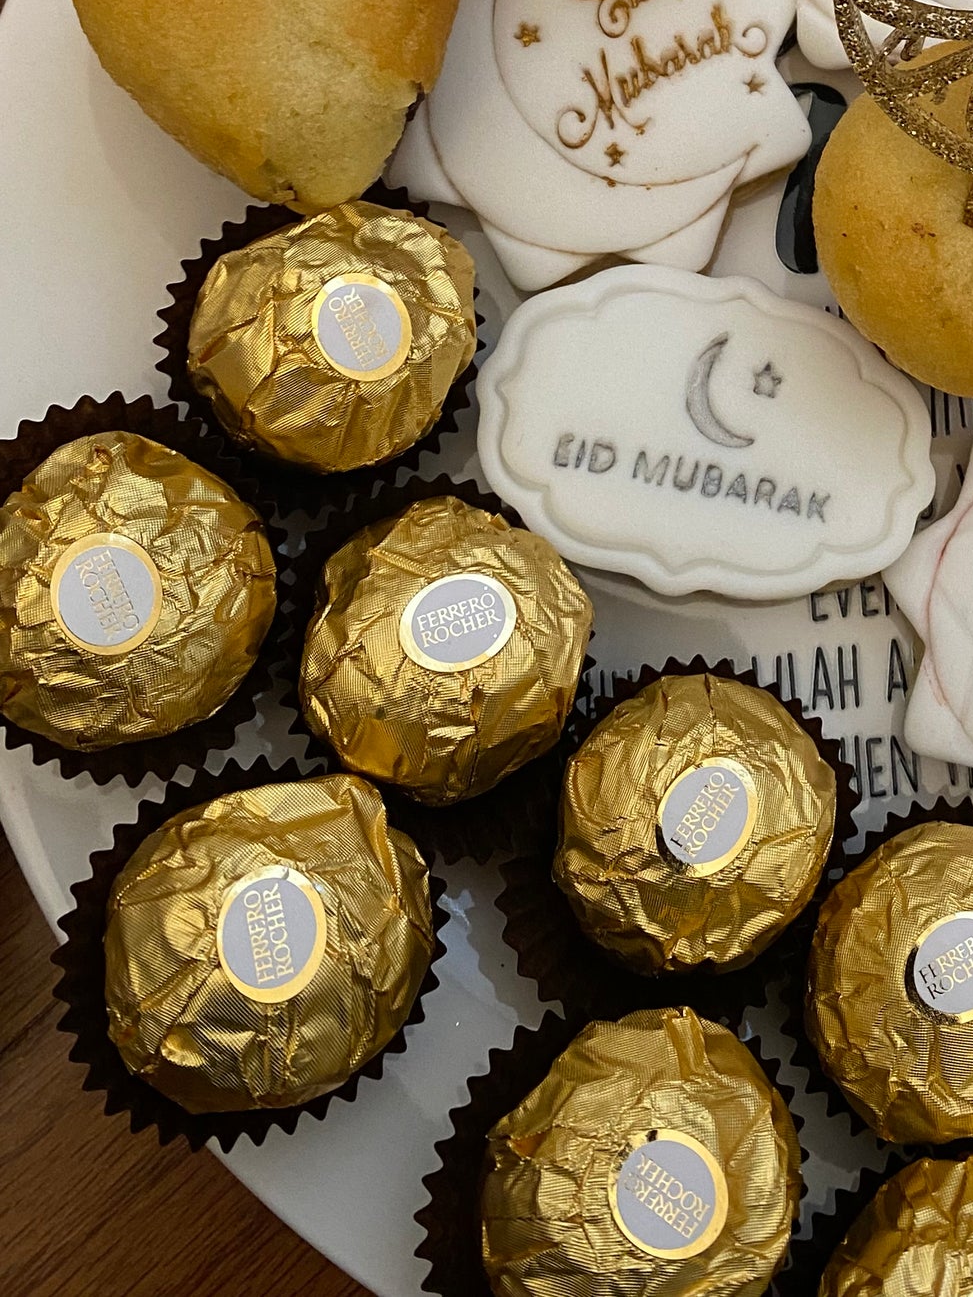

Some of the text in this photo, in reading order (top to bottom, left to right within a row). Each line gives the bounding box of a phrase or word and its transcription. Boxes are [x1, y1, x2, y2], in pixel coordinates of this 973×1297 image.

[556, 2, 769, 150] Mubarak
[328, 296, 375, 368] FERRERO
[553, 432, 831, 523] EID MUBARAK
[416, 592, 496, 632] FERRERO
[421, 608, 502, 648] ROCHER
[669, 771, 725, 848] FERRERO
[684, 782, 740, 858] ROCHER
[243, 889, 275, 985] FERRERO
[262, 883, 295, 979] ROCHER
[636, 1152, 710, 1221] ROCHER
